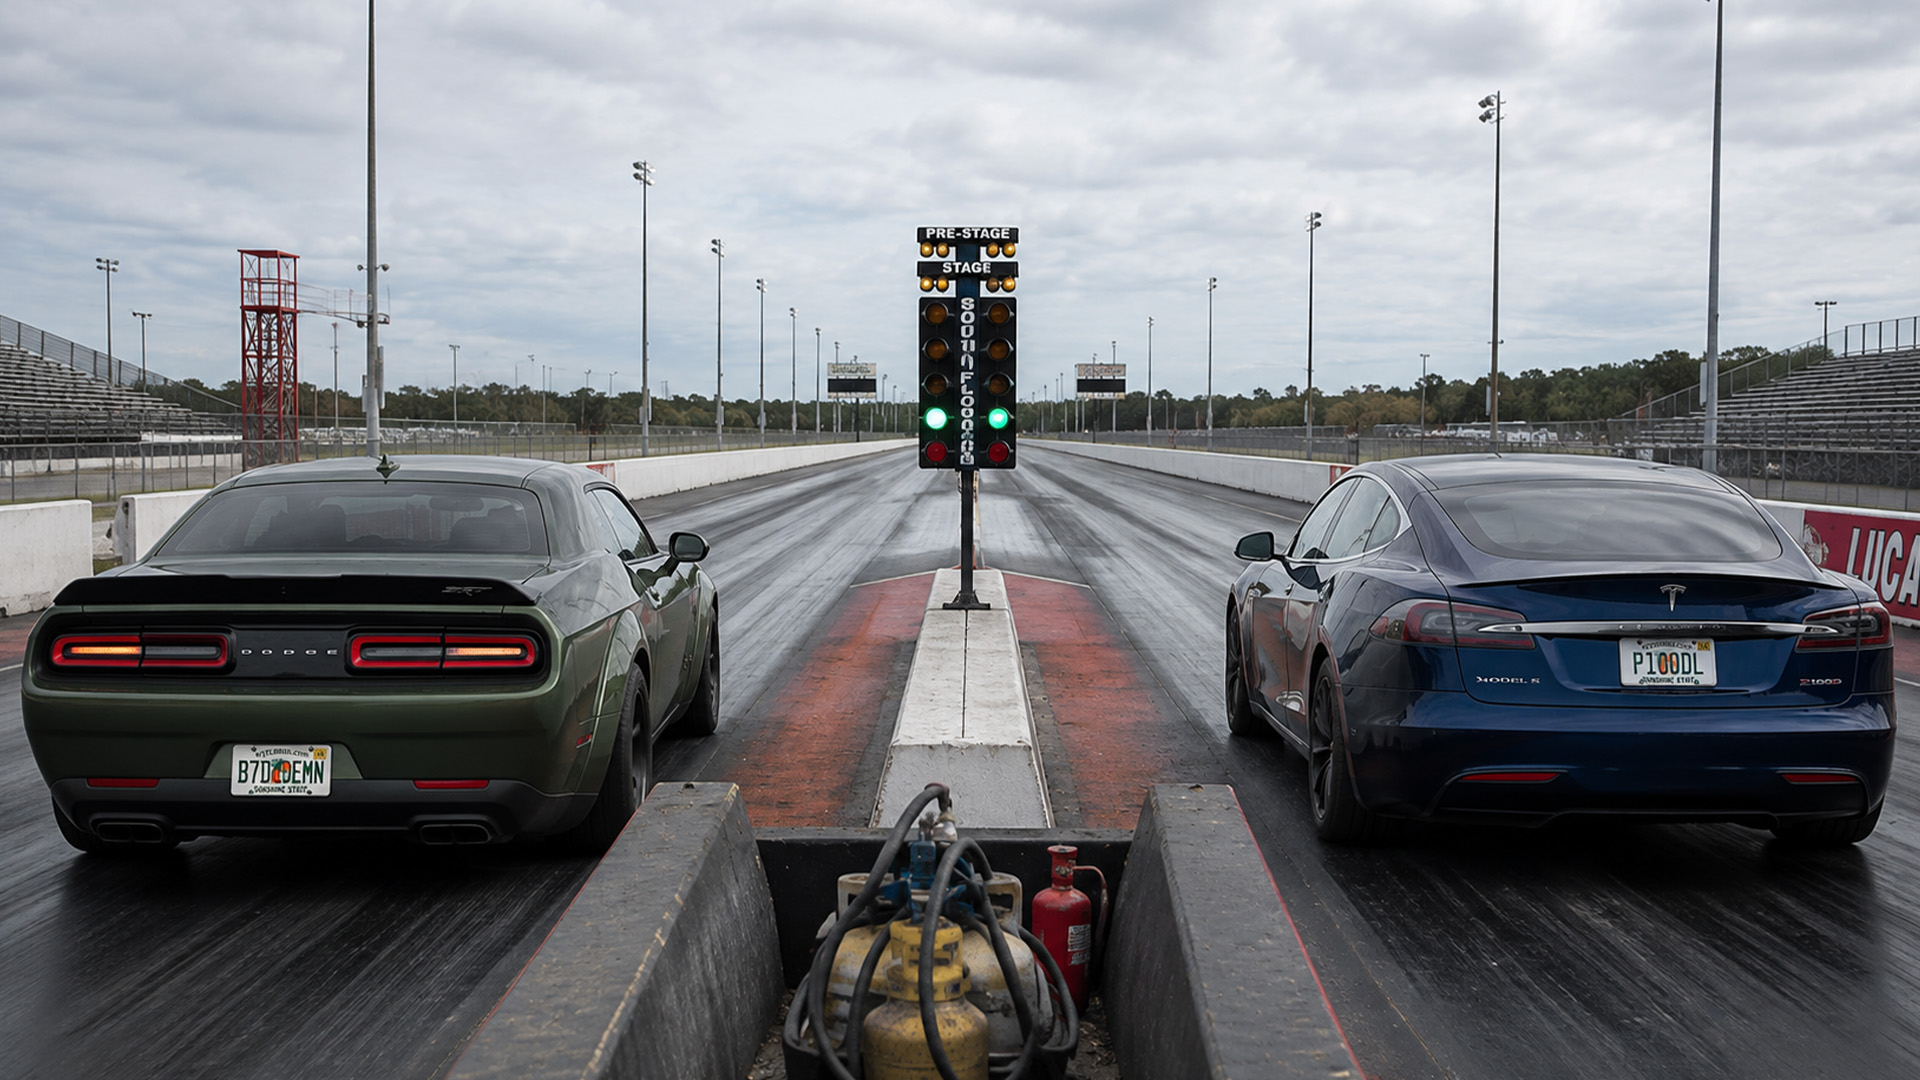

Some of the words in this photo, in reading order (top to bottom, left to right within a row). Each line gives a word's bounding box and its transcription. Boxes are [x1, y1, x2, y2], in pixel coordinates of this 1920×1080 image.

[926, 228, 1010, 239] PRE-STAGE
[942, 262, 992, 273] STAGE
[1633, 652, 1704, 675] P100DL
